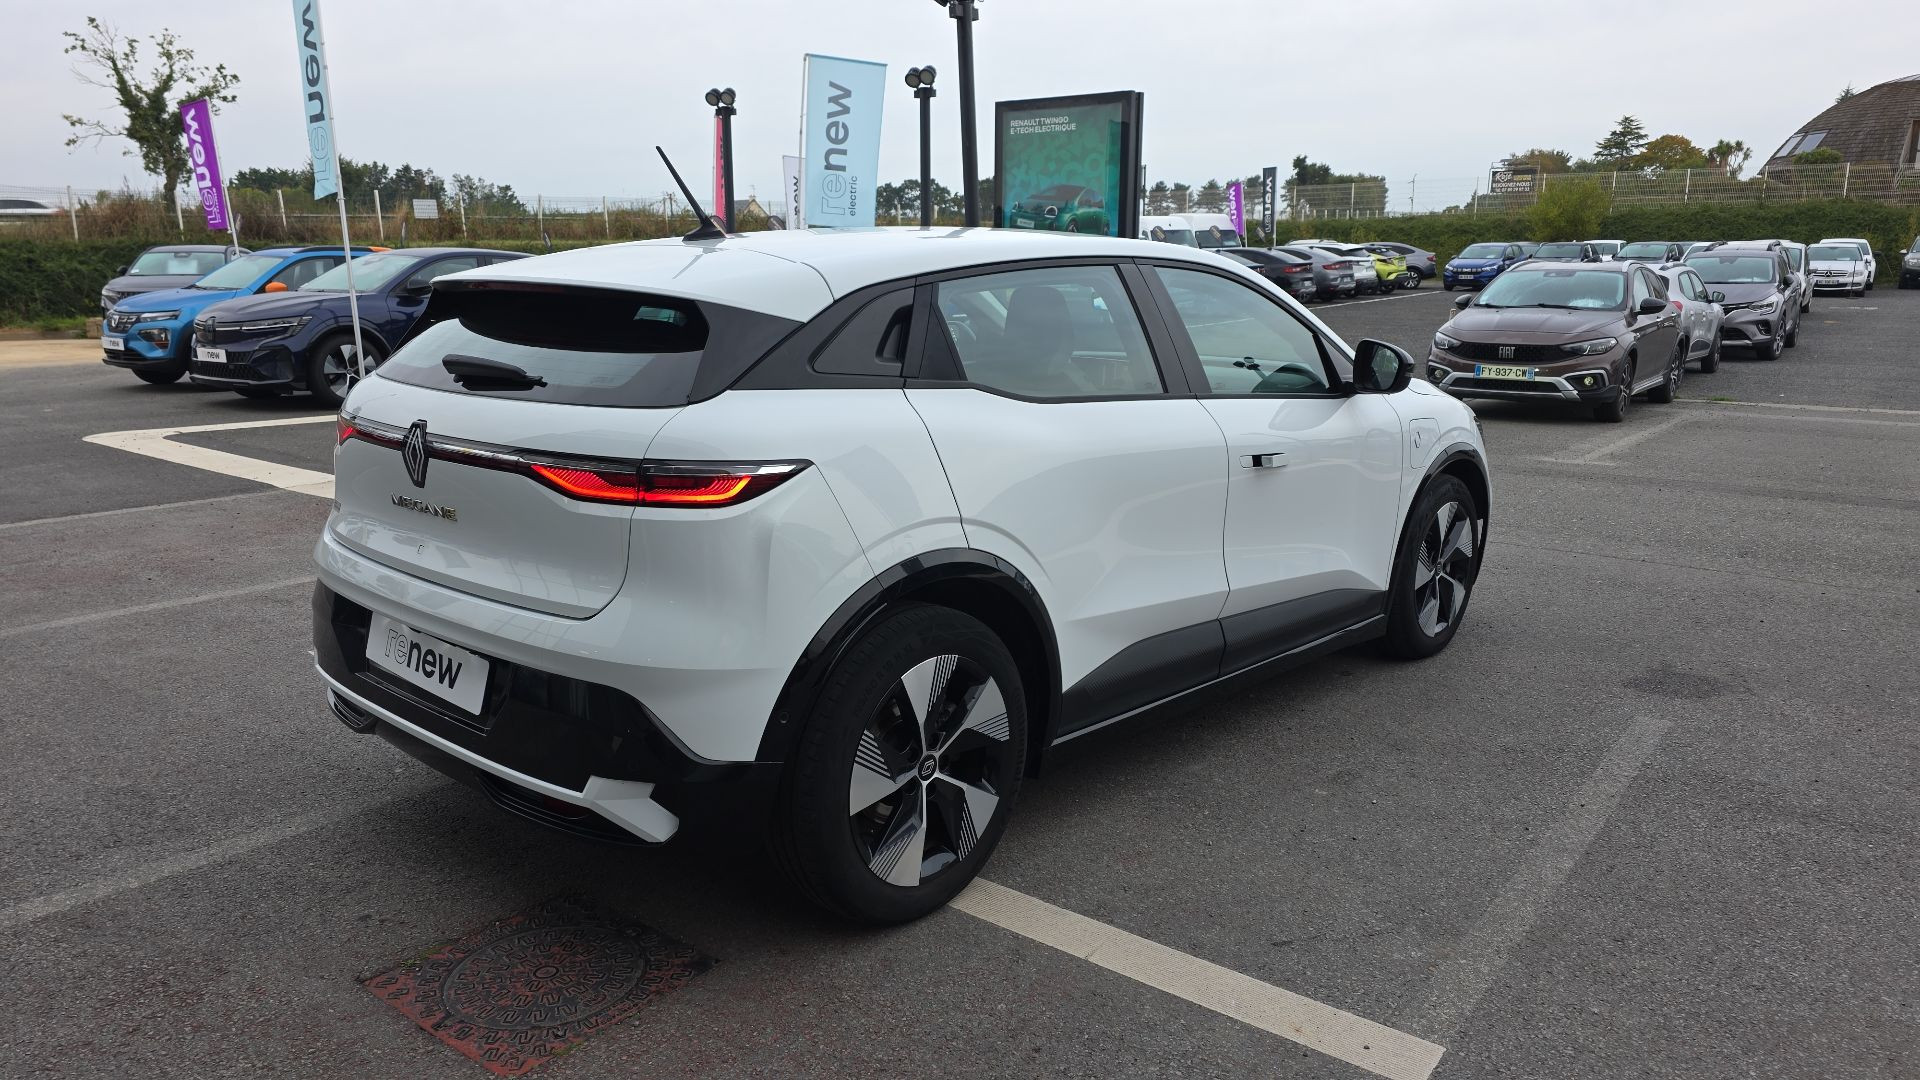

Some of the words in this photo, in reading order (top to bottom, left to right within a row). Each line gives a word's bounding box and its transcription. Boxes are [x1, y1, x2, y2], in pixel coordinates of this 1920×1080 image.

[302, 0, 331, 183] renew
[1010, 118, 1040, 128] RENAULT
[1040, 115, 1069, 125] TWINGO
[185, 108, 222, 224] renew
[822, 80, 853, 216] renew
[848, 175, 858, 217] electric
[1481, 366, 1528, 378] FY-937-CW
[1499, 346, 1516, 359] FIAT
[391, 492, 458, 522] MEGANE
[384, 628, 463, 690] renew
